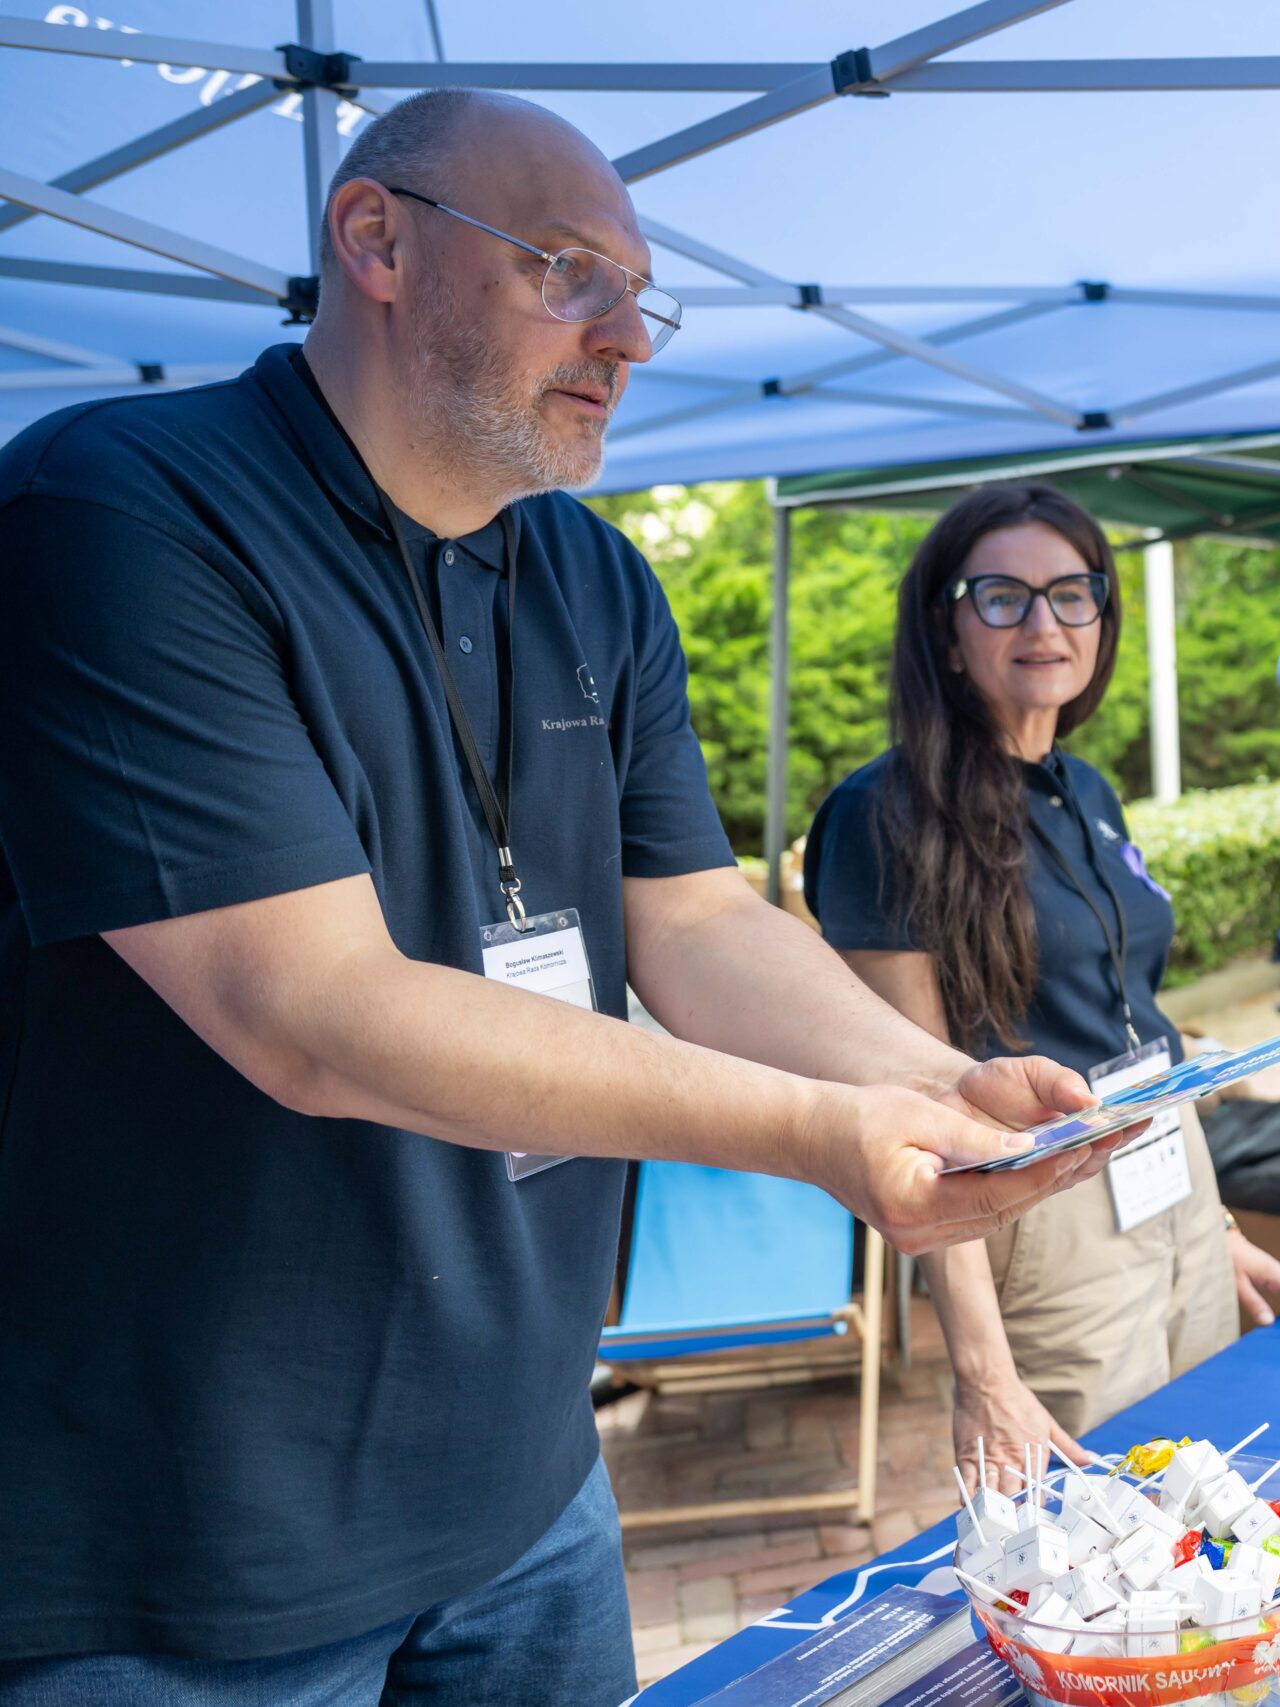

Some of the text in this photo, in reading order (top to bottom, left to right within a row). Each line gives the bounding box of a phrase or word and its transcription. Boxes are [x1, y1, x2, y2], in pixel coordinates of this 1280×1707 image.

[541, 715, 605, 731] Krajowa Ra
[505, 949, 564, 969] Bogusław Klimaszewski
[506, 968, 527, 979] Krajowa
[527, 965, 540, 974] Rada
[1055, 1669, 1152, 1694] KOMORNIK
